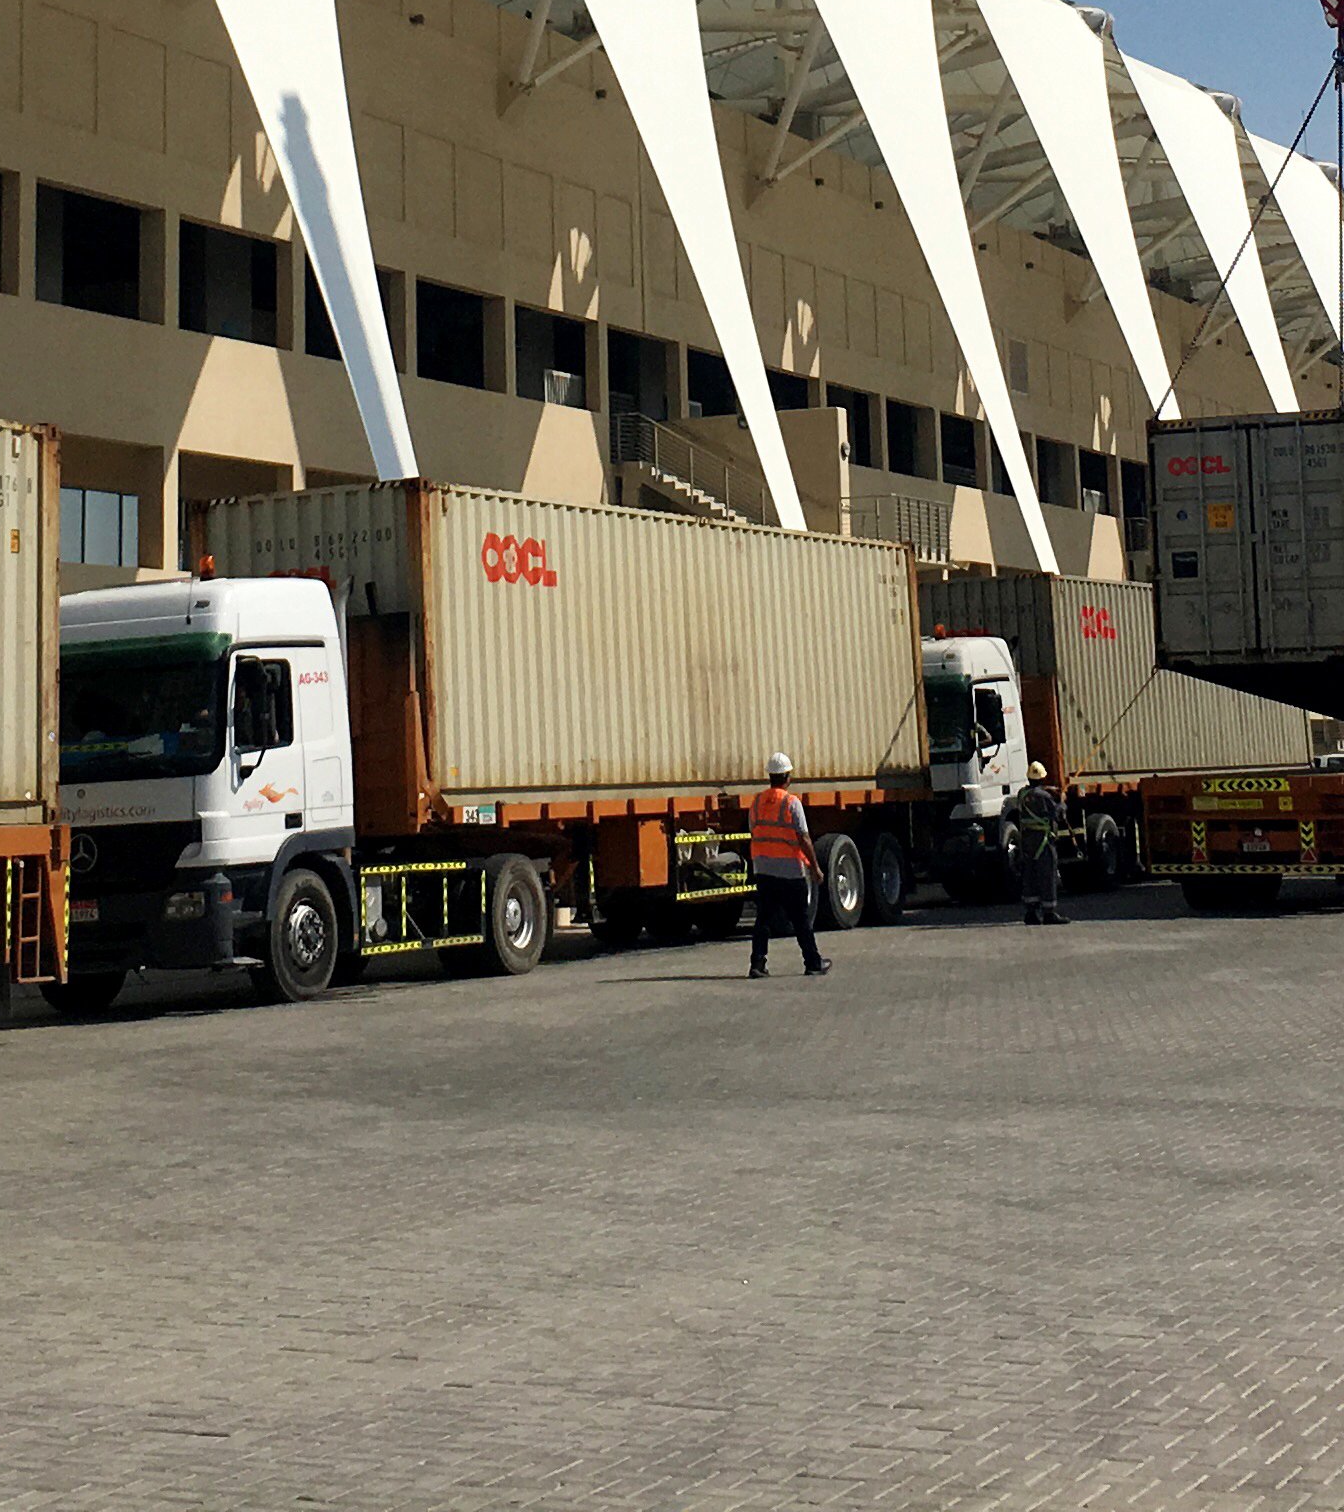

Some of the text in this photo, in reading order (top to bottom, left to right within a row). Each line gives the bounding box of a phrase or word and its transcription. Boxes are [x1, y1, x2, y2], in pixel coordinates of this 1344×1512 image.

[1168, 455, 1231, 476] OOCL
[481, 532, 557, 587] OOCL
[299, 671, 329, 685] AG-343
